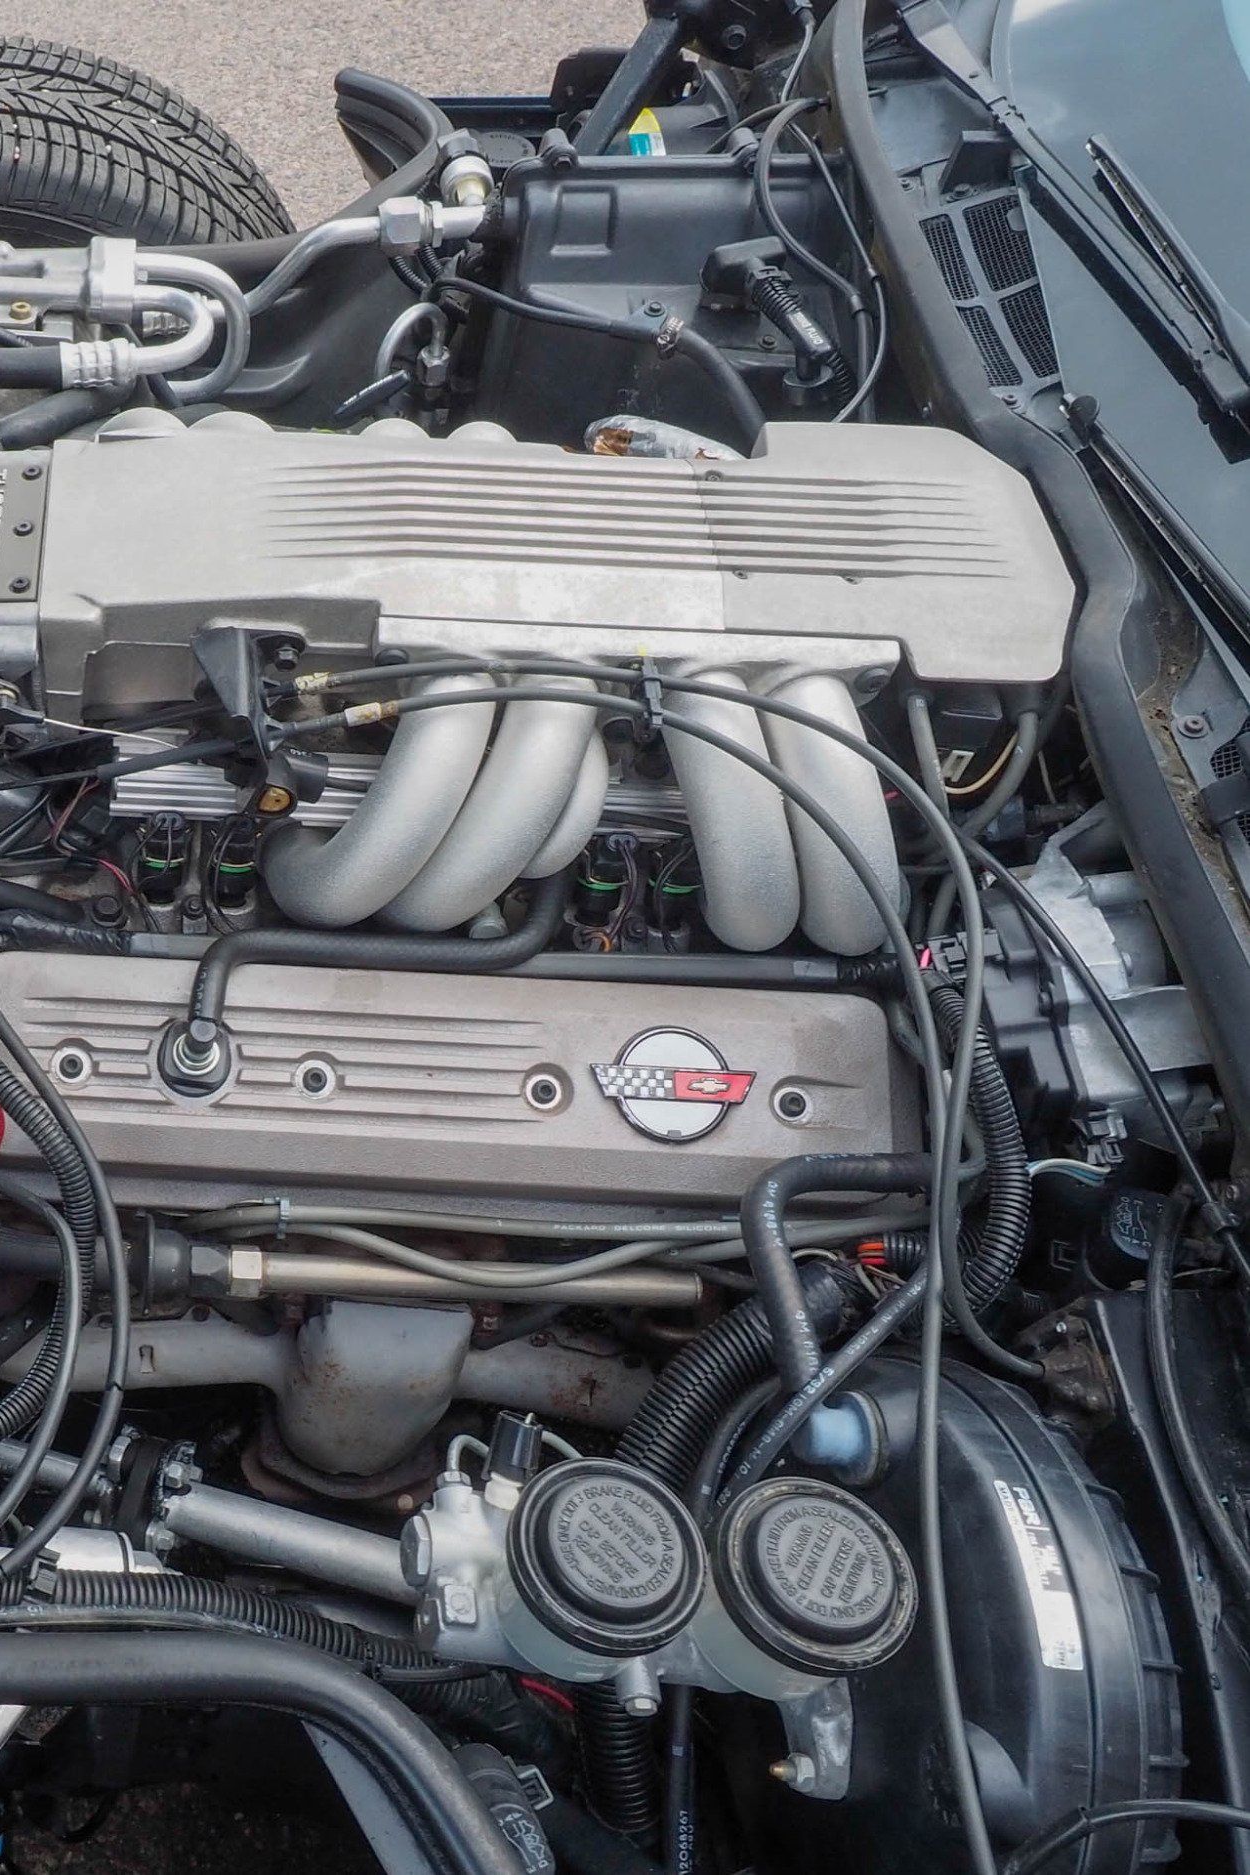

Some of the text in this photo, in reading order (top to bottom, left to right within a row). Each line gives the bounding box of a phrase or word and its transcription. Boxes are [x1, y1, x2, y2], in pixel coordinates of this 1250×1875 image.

[675, 1224, 728, 1232] SILICONE
[584, 1486, 626, 1499] BRAKE
[624, 1490, 655, 1514] FLUID
[651, 1511, 674, 1543] FROM
[589, 1502, 656, 1569] CLEAN FILLER
[611, 1501, 656, 1545] WARNING
[574, 1535, 623, 1583] REMOVING
[579, 1520, 638, 1578] CAP BEFORE
[785, 1523, 814, 1569] WARNING
[797, 1522, 837, 1590] CLEAN FILLER
[819, 1537, 855, 1599] CAP BEFORE
[838, 1553, 868, 1603] REMOVING
